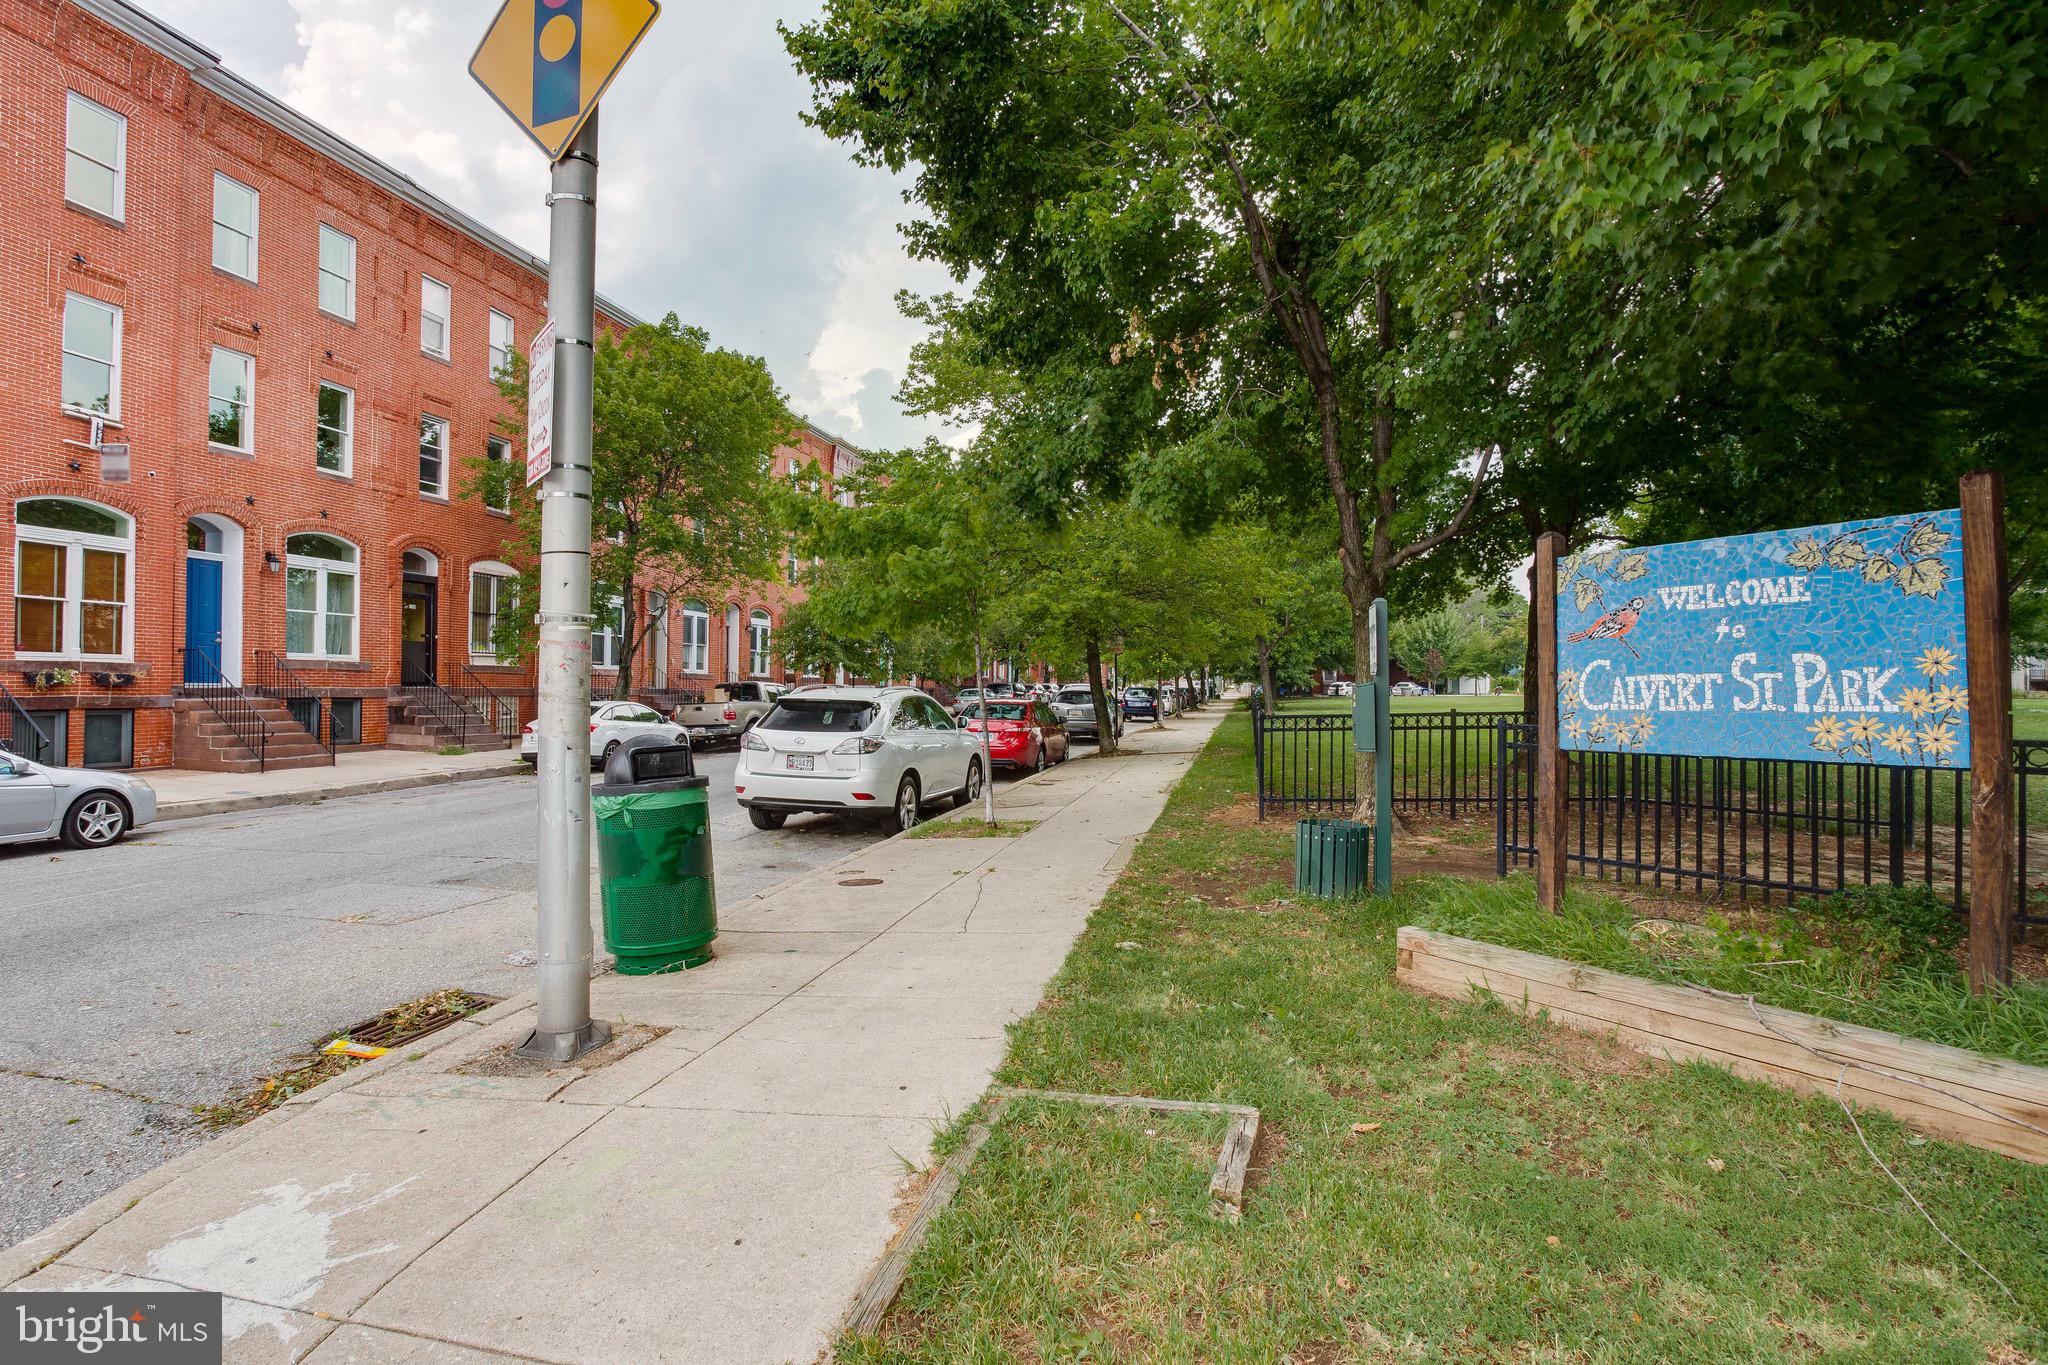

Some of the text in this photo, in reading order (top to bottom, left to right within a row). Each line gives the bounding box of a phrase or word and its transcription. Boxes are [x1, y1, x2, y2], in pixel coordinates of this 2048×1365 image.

[532, 363, 551, 396] TUESDAY
[1656, 575, 1811, 611] WELCOME
[1714, 616, 1746, 645] to
[1578, 659, 1723, 712] CALVERT
[1792, 652, 1899, 713] PARK
